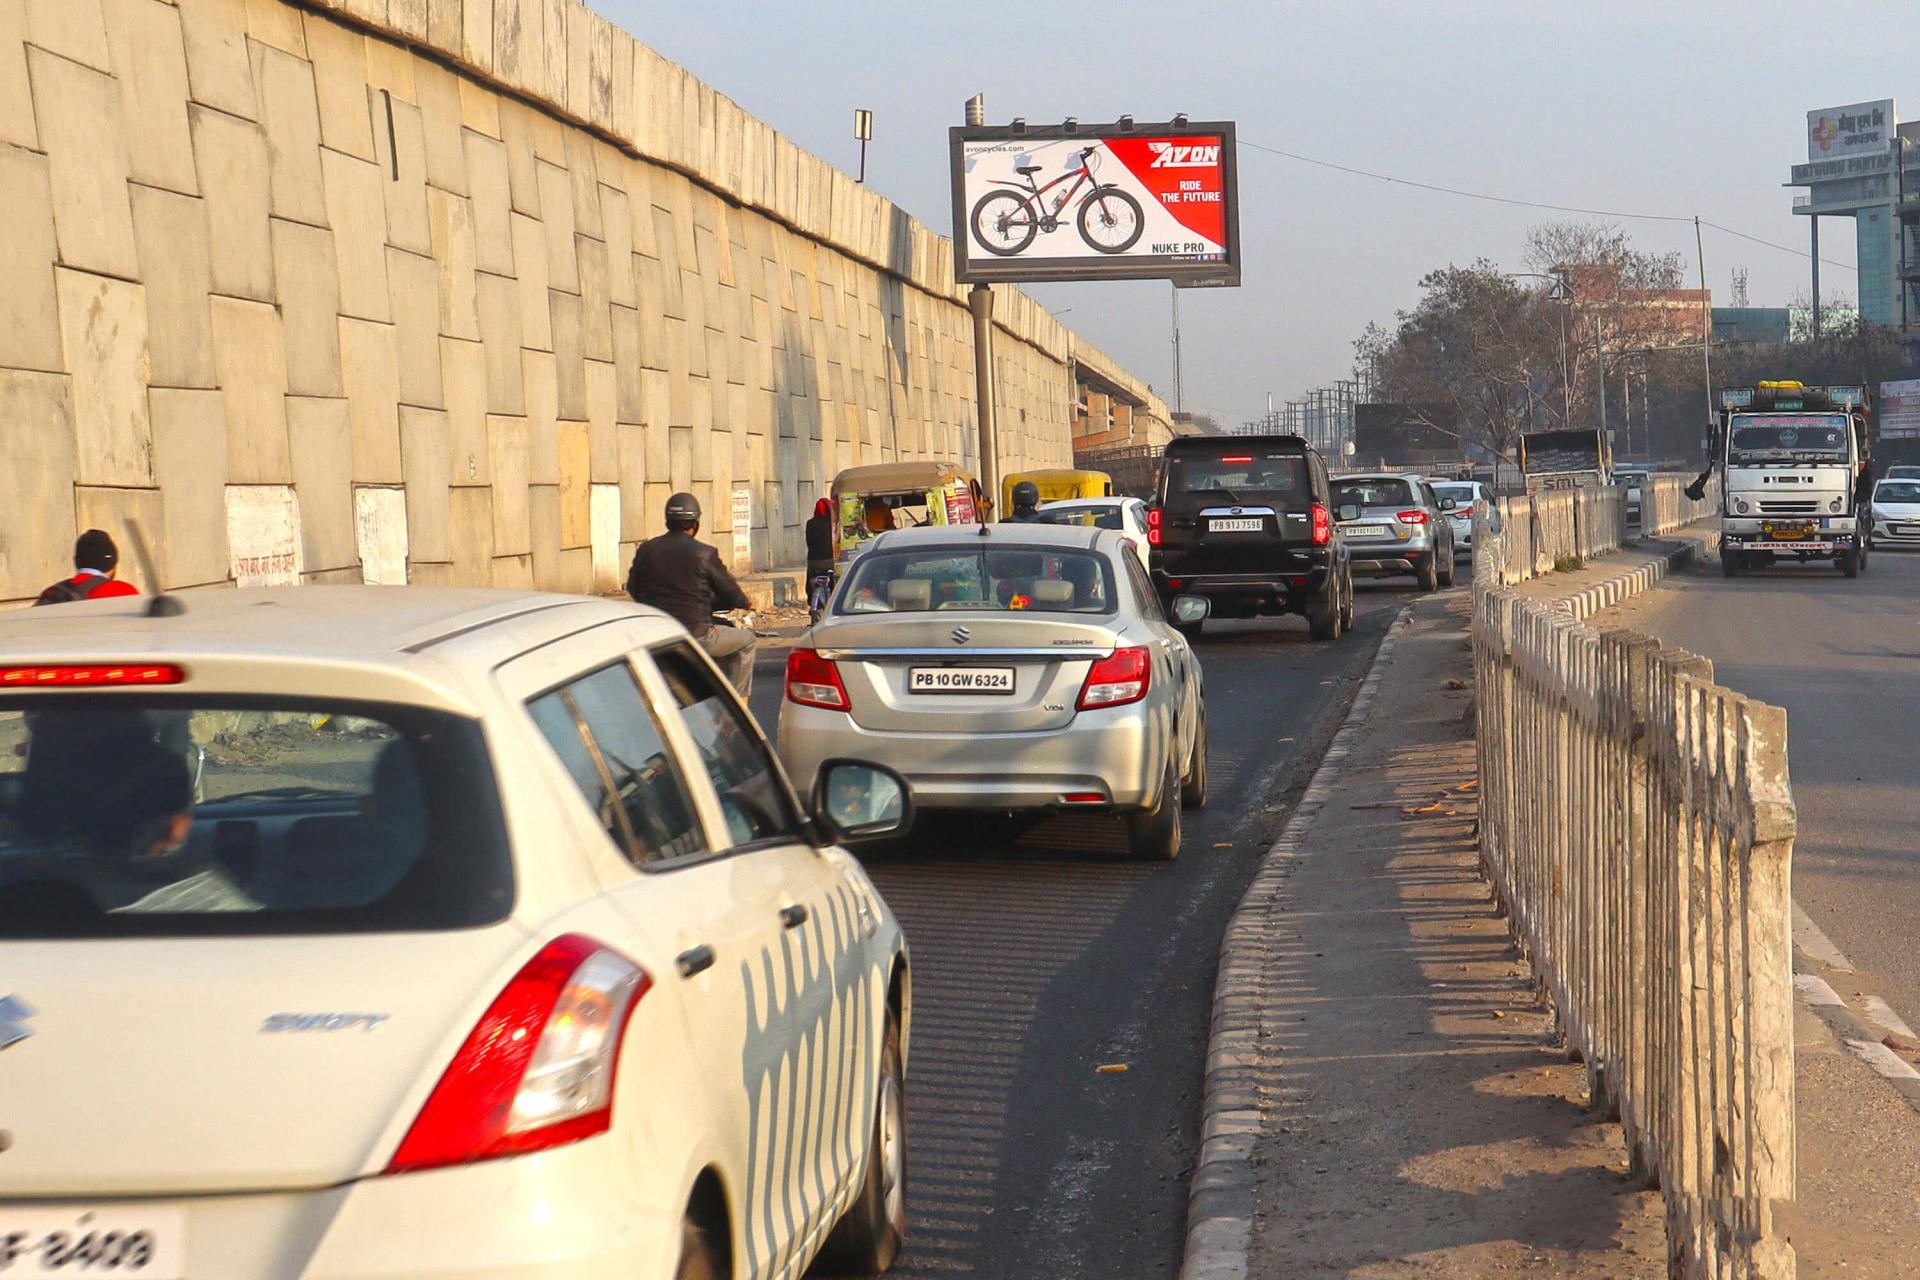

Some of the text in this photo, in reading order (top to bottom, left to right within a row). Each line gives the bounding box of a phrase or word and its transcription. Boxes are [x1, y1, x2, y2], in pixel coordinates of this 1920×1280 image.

[965, 146, 1025, 154] avoncycles.com
[1148, 143, 1220, 168] AVON
[1180, 180, 1202, 191] RIDE
[1161, 191, 1222, 203] THE FUTURE
[1152, 242, 1205, 254] NUKE PRO
[1214, 521, 1224, 530] PB
[916, 673, 1008, 687] PB 10 GW 6324
